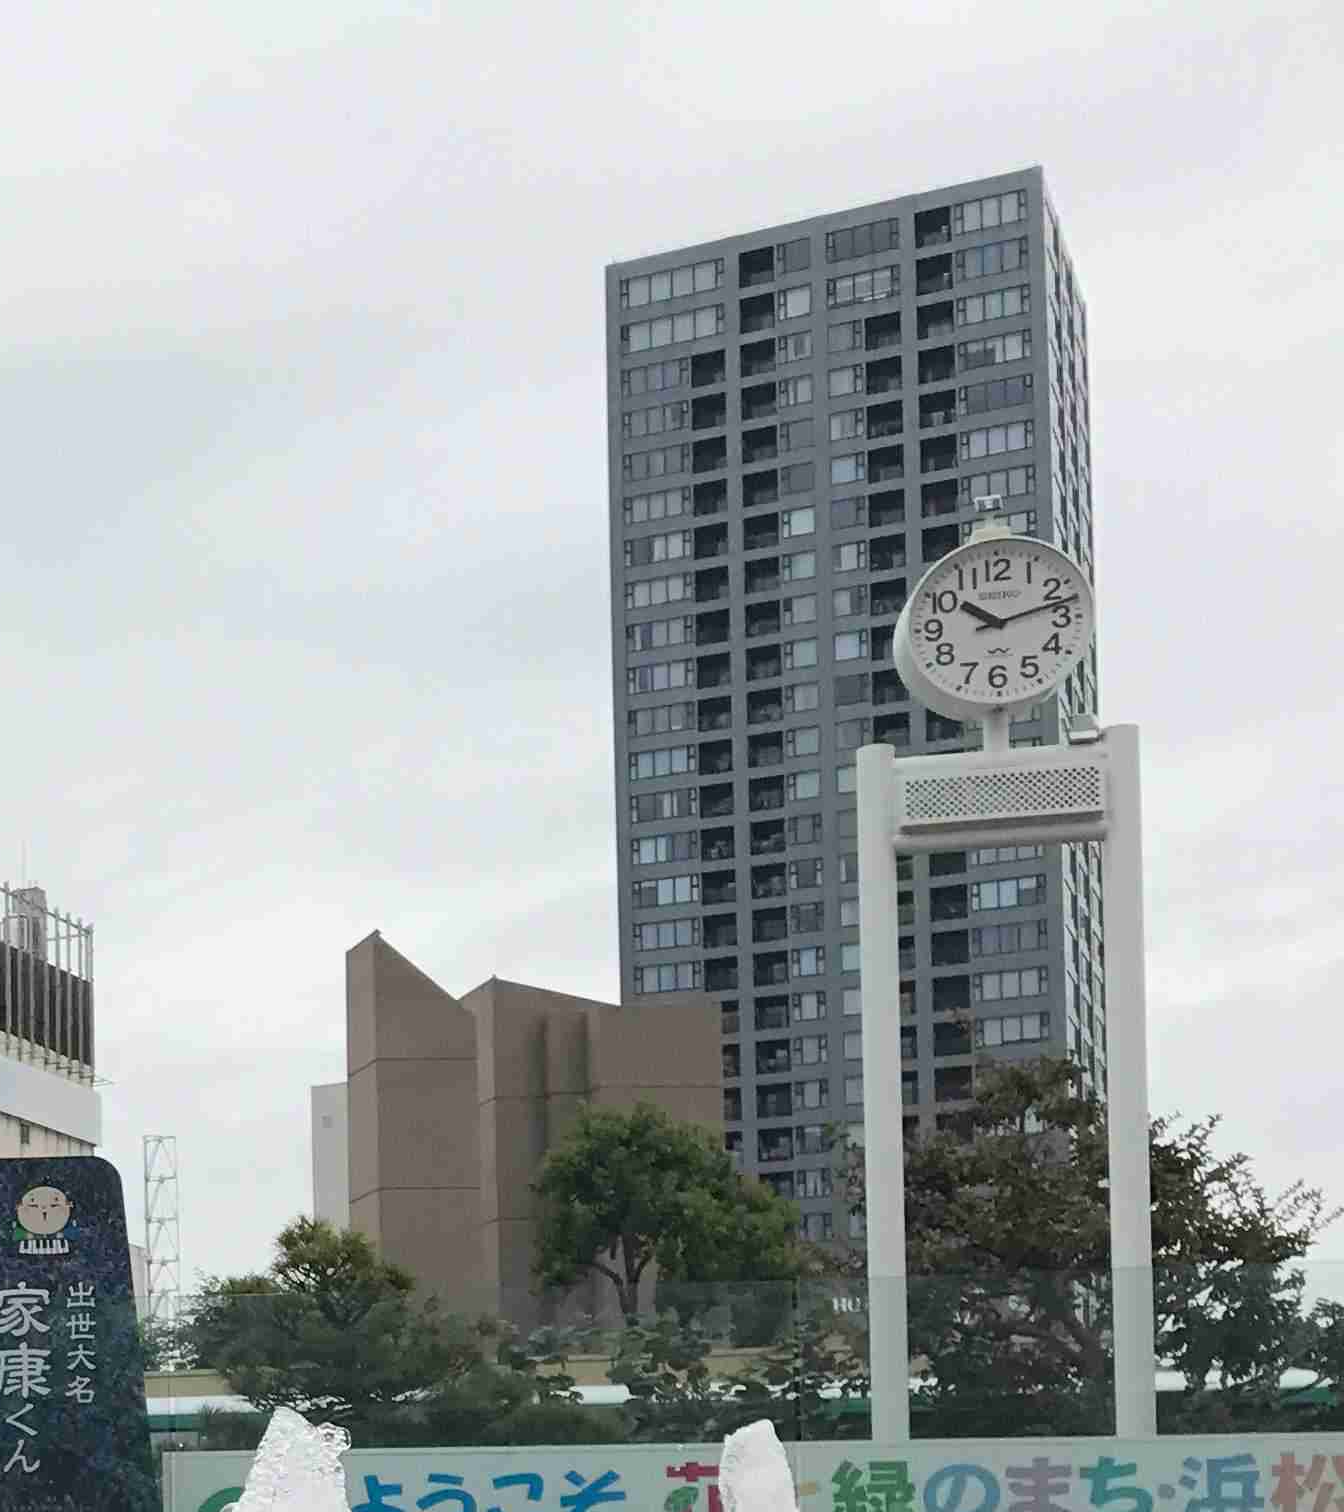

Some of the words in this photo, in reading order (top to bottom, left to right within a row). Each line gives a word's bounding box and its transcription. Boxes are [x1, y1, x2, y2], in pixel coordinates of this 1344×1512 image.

[958, 567, 977, 591] 11
[985, 558, 1011, 583] 12
[1026, 561, 1032, 584] 1
[1043, 577, 1062, 602] 2
[932, 590, 958, 614] 10
[1051, 604, 1071, 628] 3
[924, 619, 943, 642] 9
[935, 642, 955, 666] 8
[1042, 632, 1062, 655] 4
[960, 662, 979, 685] 7
[988, 665, 1008, 689] 6
[1020, 655, 1039, 679] 5
[64, 1280, 97, 1404] 出世大名
